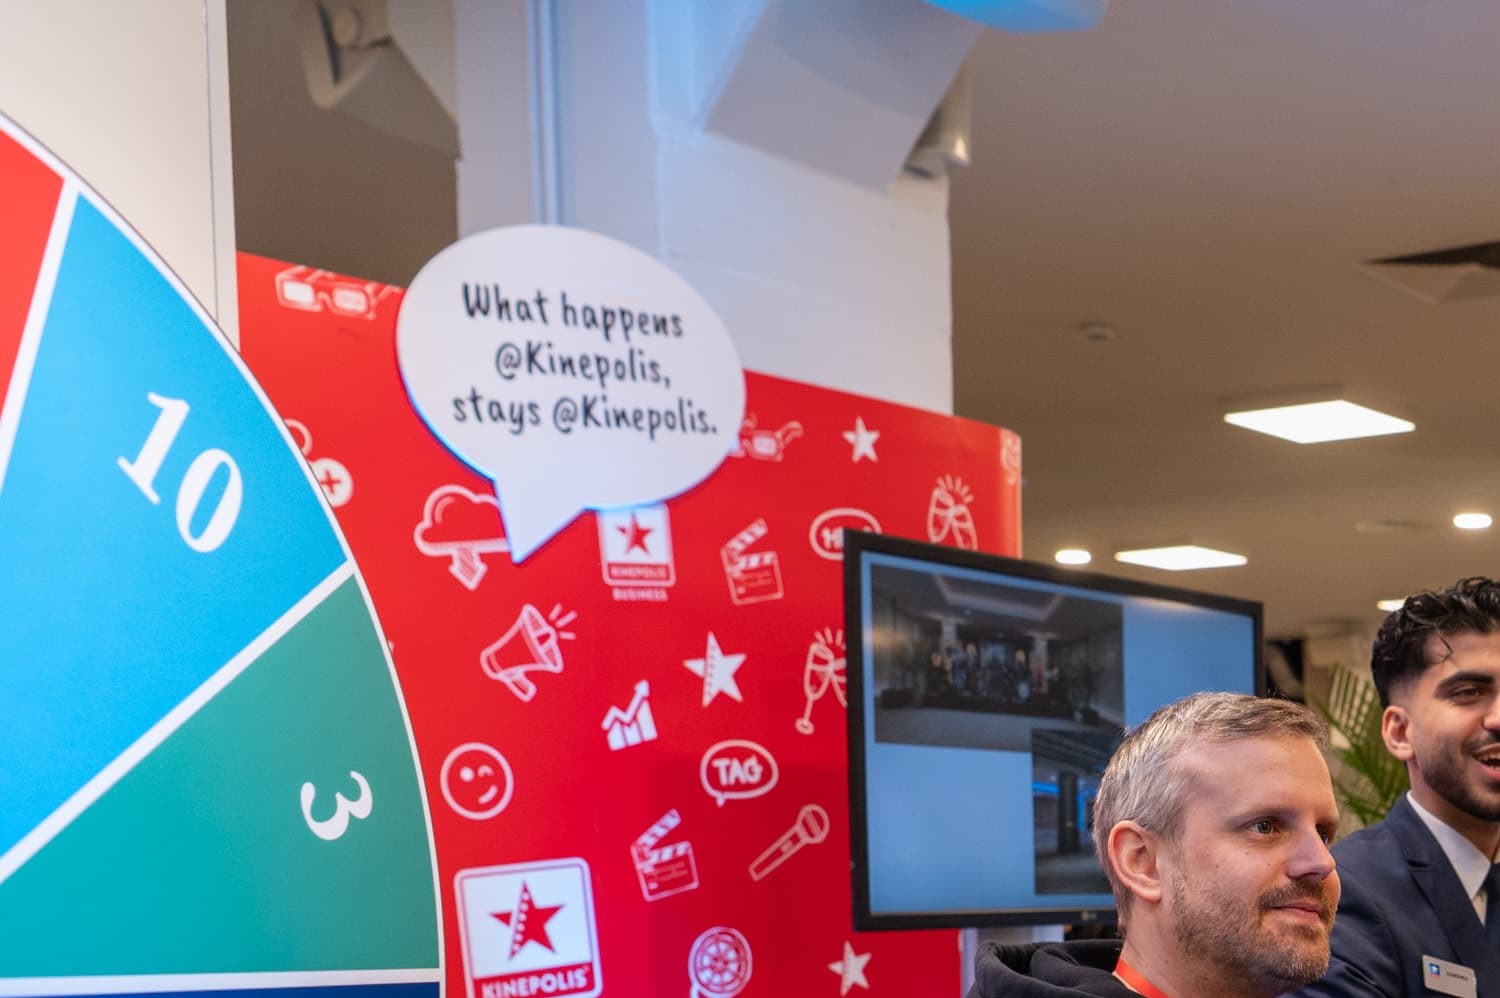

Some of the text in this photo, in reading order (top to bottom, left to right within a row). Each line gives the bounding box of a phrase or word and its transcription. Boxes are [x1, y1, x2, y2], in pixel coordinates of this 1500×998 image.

[462, 281, 684, 342] What happens
[494, 340, 671, 389] @Kinepolis,
[452, 386, 719, 441] stays @Kinepolis.
[116, 391, 243, 553] 10
[712, 754, 764, 787] TAG
[300, 770, 373, 841] 3
